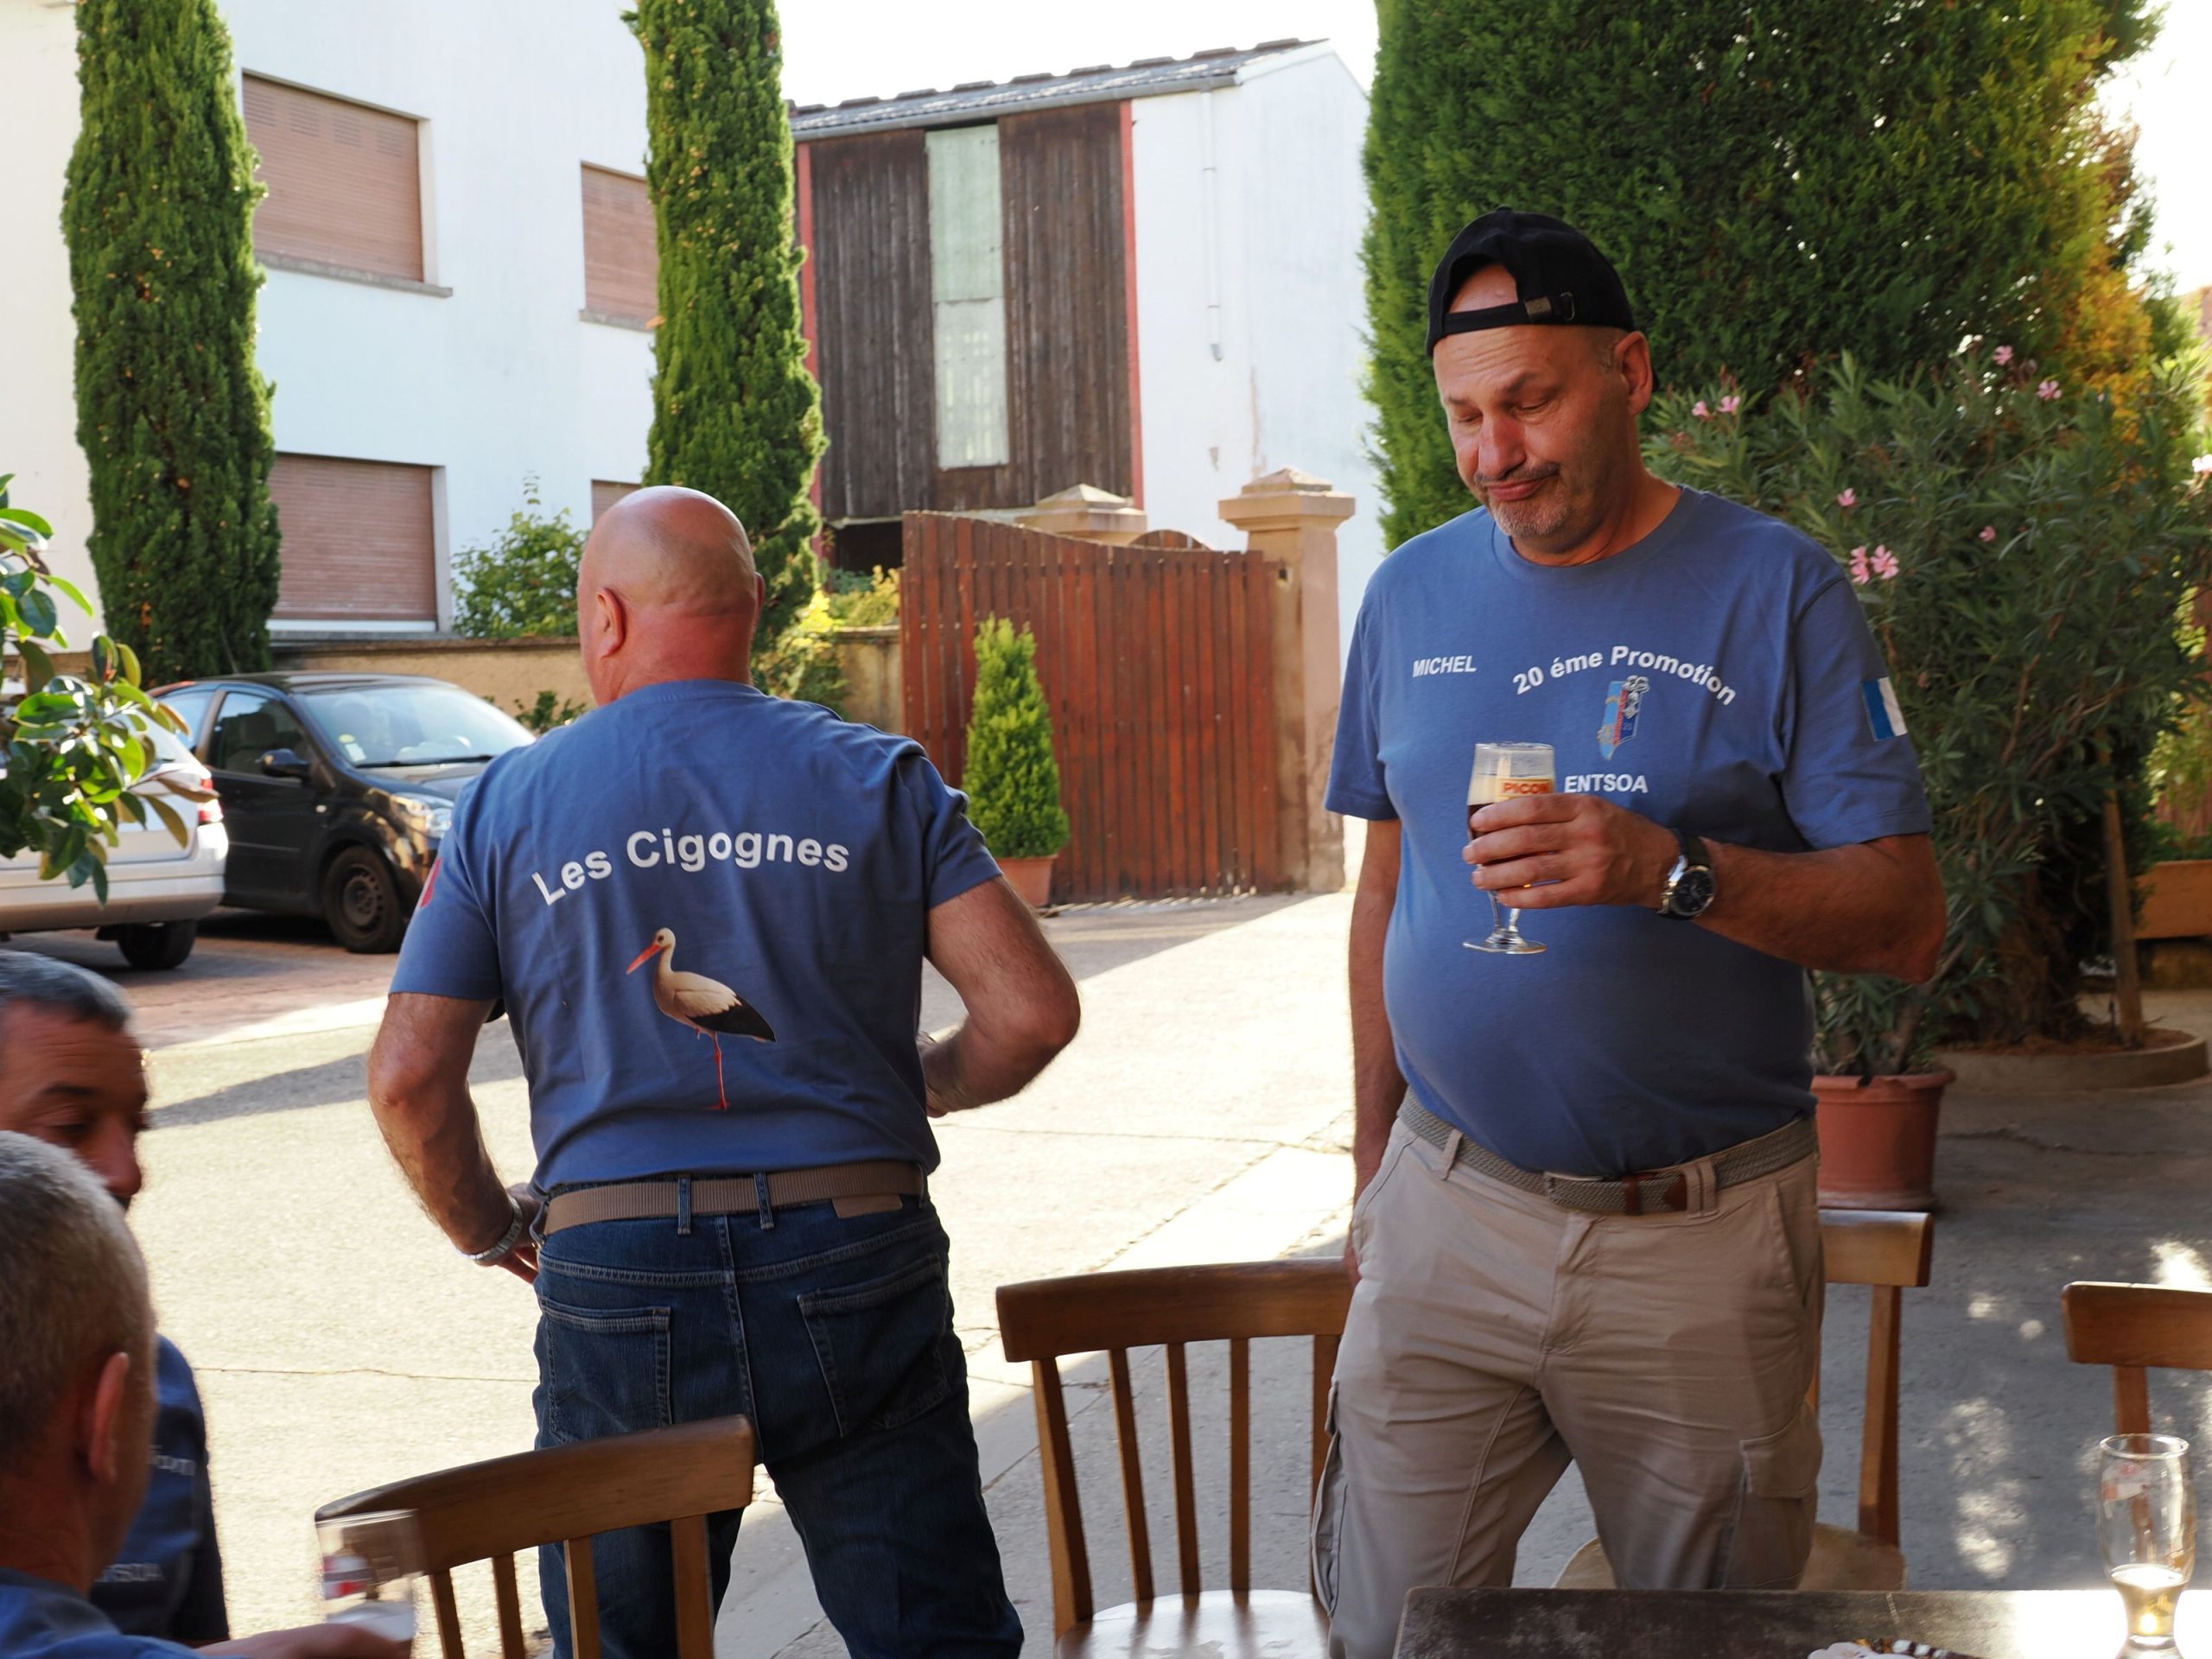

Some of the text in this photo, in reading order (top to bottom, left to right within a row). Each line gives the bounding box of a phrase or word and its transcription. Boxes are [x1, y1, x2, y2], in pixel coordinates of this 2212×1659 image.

[1412, 655, 1477, 678] MICHEL
[1512, 666, 1544, 695] 20
[1610, 645, 1736, 706] Promotion
[1563, 773, 1648, 794] ENTSOA
[531, 828, 849, 906] Les Cigognes
